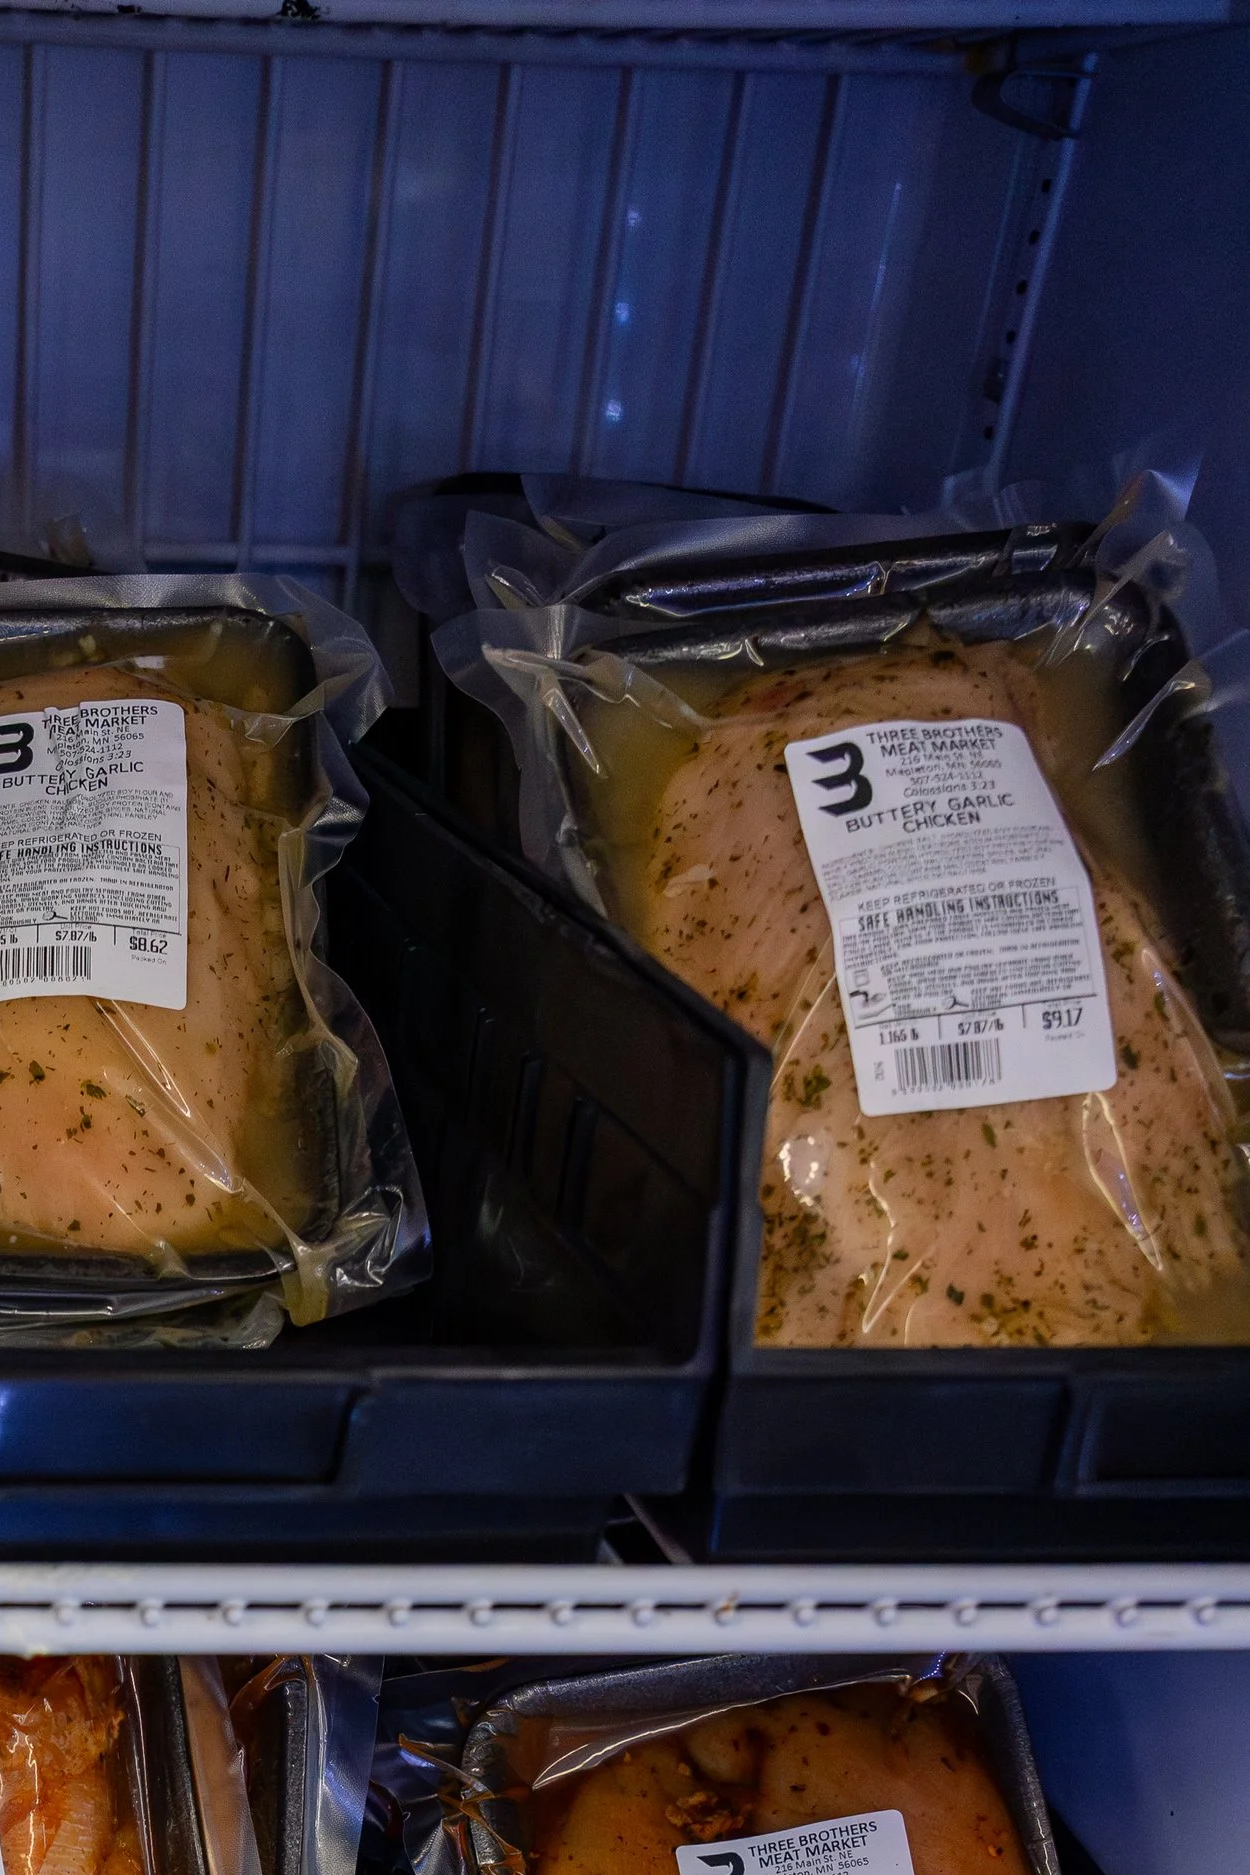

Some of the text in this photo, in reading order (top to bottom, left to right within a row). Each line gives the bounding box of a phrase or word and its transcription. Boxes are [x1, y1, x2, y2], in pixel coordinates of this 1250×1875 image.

[79, 705, 158, 720] BROTHERS
[85, 715, 147, 729] MARKET
[113, 732, 145, 742] 56065
[116, 725, 130, 733] NE
[866, 726, 1003, 744] THREE BROTHERS
[106, 749, 132, 761] 3:23
[880, 737, 996, 757] MEAT MARKET
[85, 761, 144, 779] GARLIC
[45, 776, 109, 796] CHICKEN
[844, 793, 1014, 833] BUTTERY GARLIC
[902, 810, 981, 833] CHICKEN
[17, 831, 98, 847] REFRIGERATED
[99, 829, 115, 838] OR
[119, 829, 162, 842] FROZEN
[17, 843, 76, 858] HANDLING
[81, 840, 163, 856] INSTRUCTIONS
[857, 876, 1055, 912] KEEP REFRIGERATED OR FROZEN
[858, 911, 890, 932] SAFE
[9, 933, 18, 944] lb
[55, 926, 97, 942] $7.87/lb
[129, 934, 168, 955] $8.62
[747, 1820, 877, 1857] THREE BROTHERS
[758, 1834, 867, 1869] MEAT MARKET
[774, 1849, 853, 1874] 216 Main St. NE
[815, 1863, 834, 1875] MN
[837, 1856, 869, 1870] 56065
